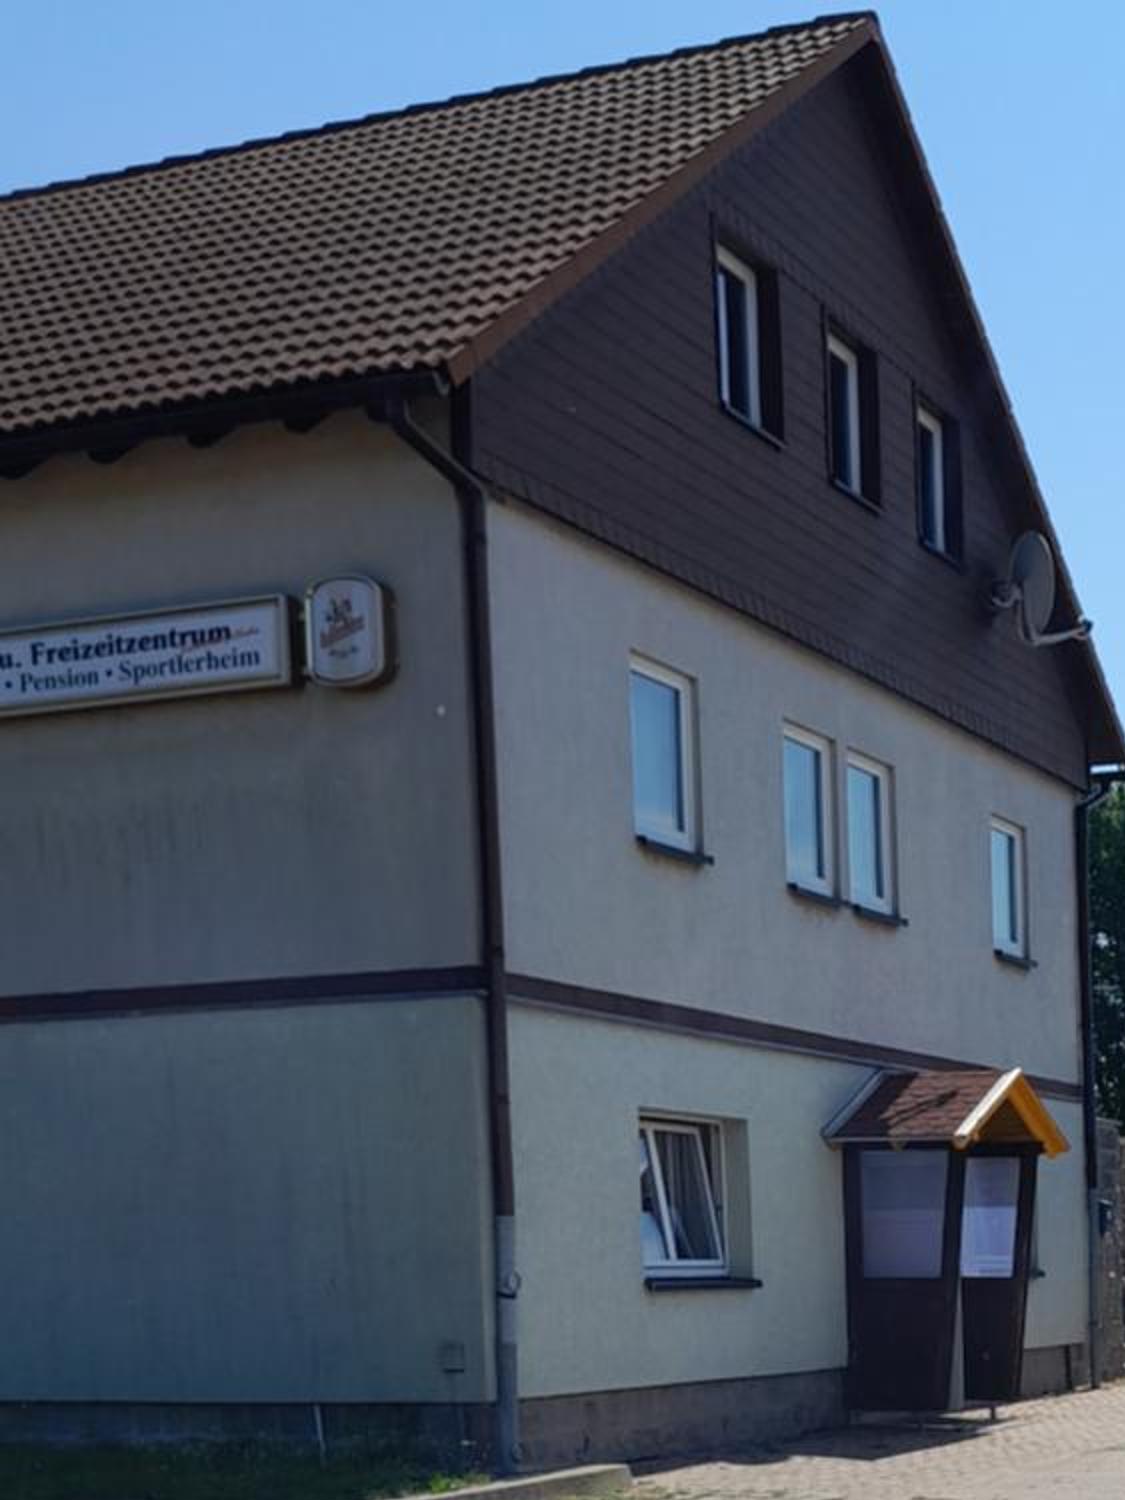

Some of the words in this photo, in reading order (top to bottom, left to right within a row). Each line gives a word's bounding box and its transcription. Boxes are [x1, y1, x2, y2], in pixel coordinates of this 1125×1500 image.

[30, 625, 232, 667] Freizeitzentrum
[20, 668, 99, 693] Pension
[118, 647, 261, 685] Sportlerheim
